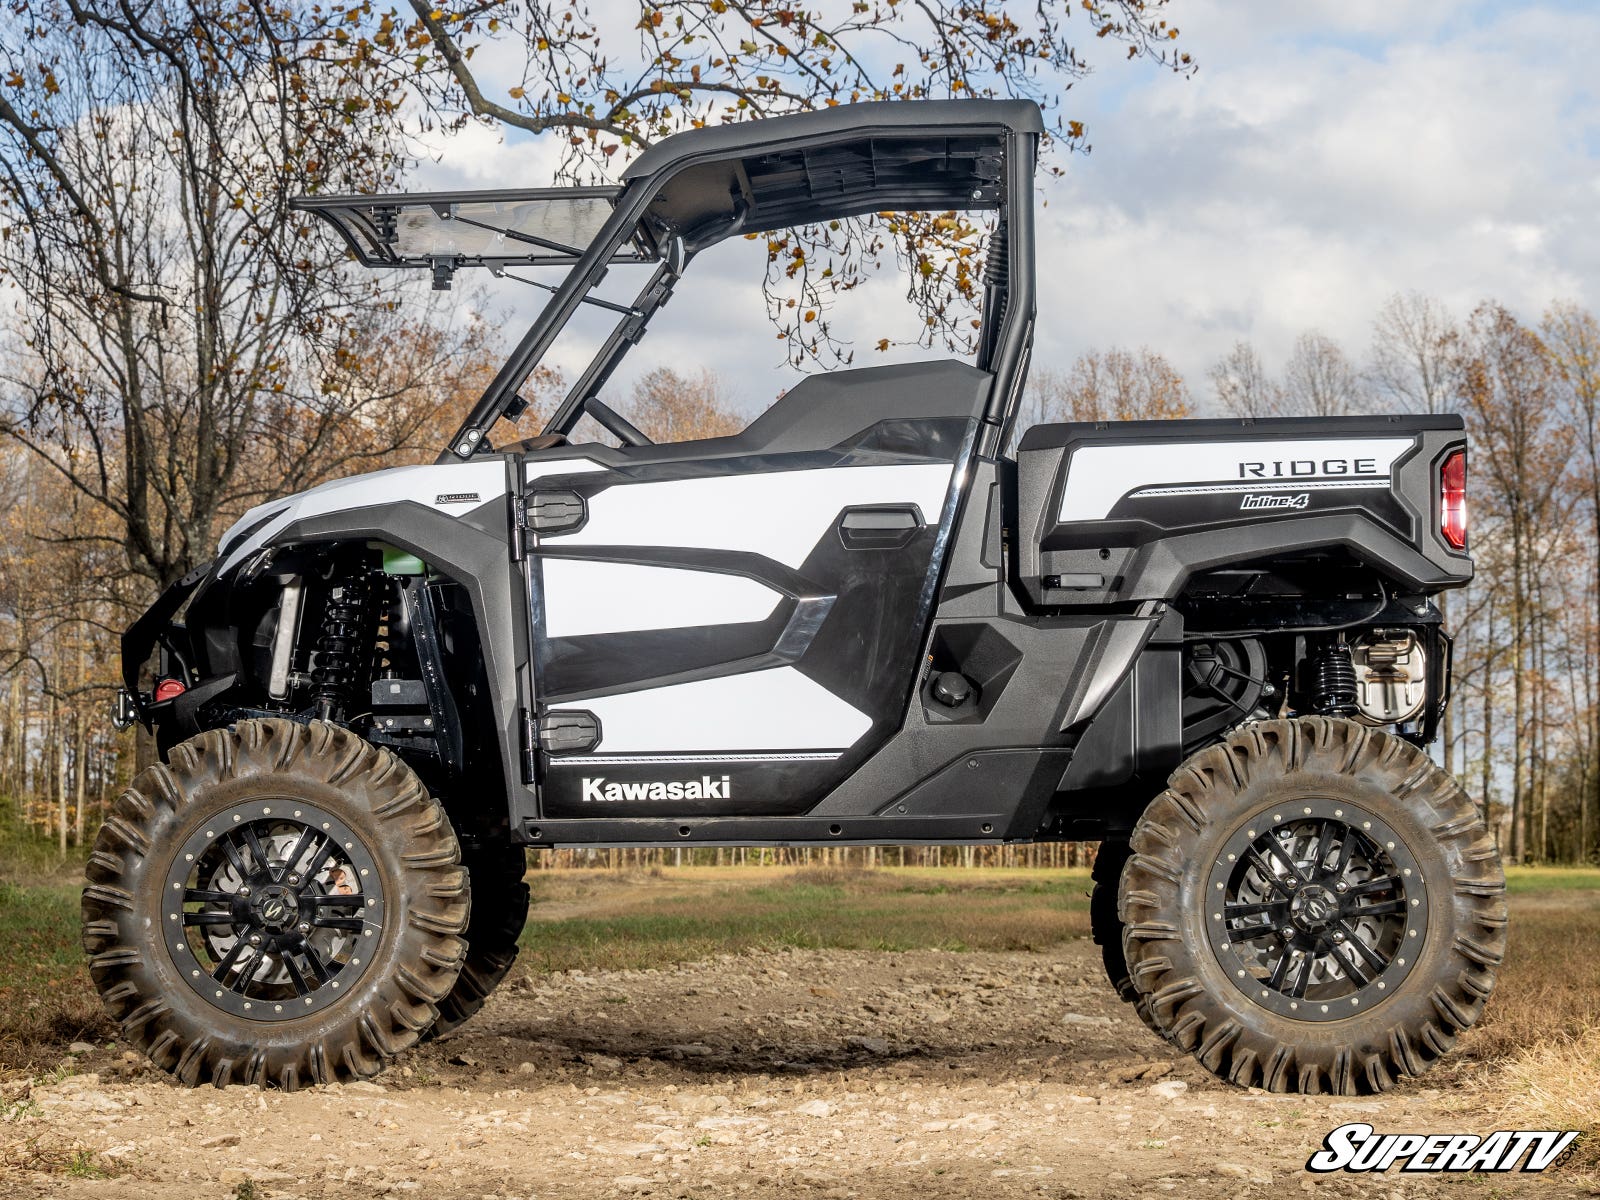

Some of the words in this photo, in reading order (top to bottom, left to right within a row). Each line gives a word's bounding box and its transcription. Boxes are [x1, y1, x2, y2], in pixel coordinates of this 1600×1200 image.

[1239, 459, 1377, 478] RIDGE
[1240, 493, 1310, 510] Inline-4
[582, 775, 731, 802] Kawasaki
